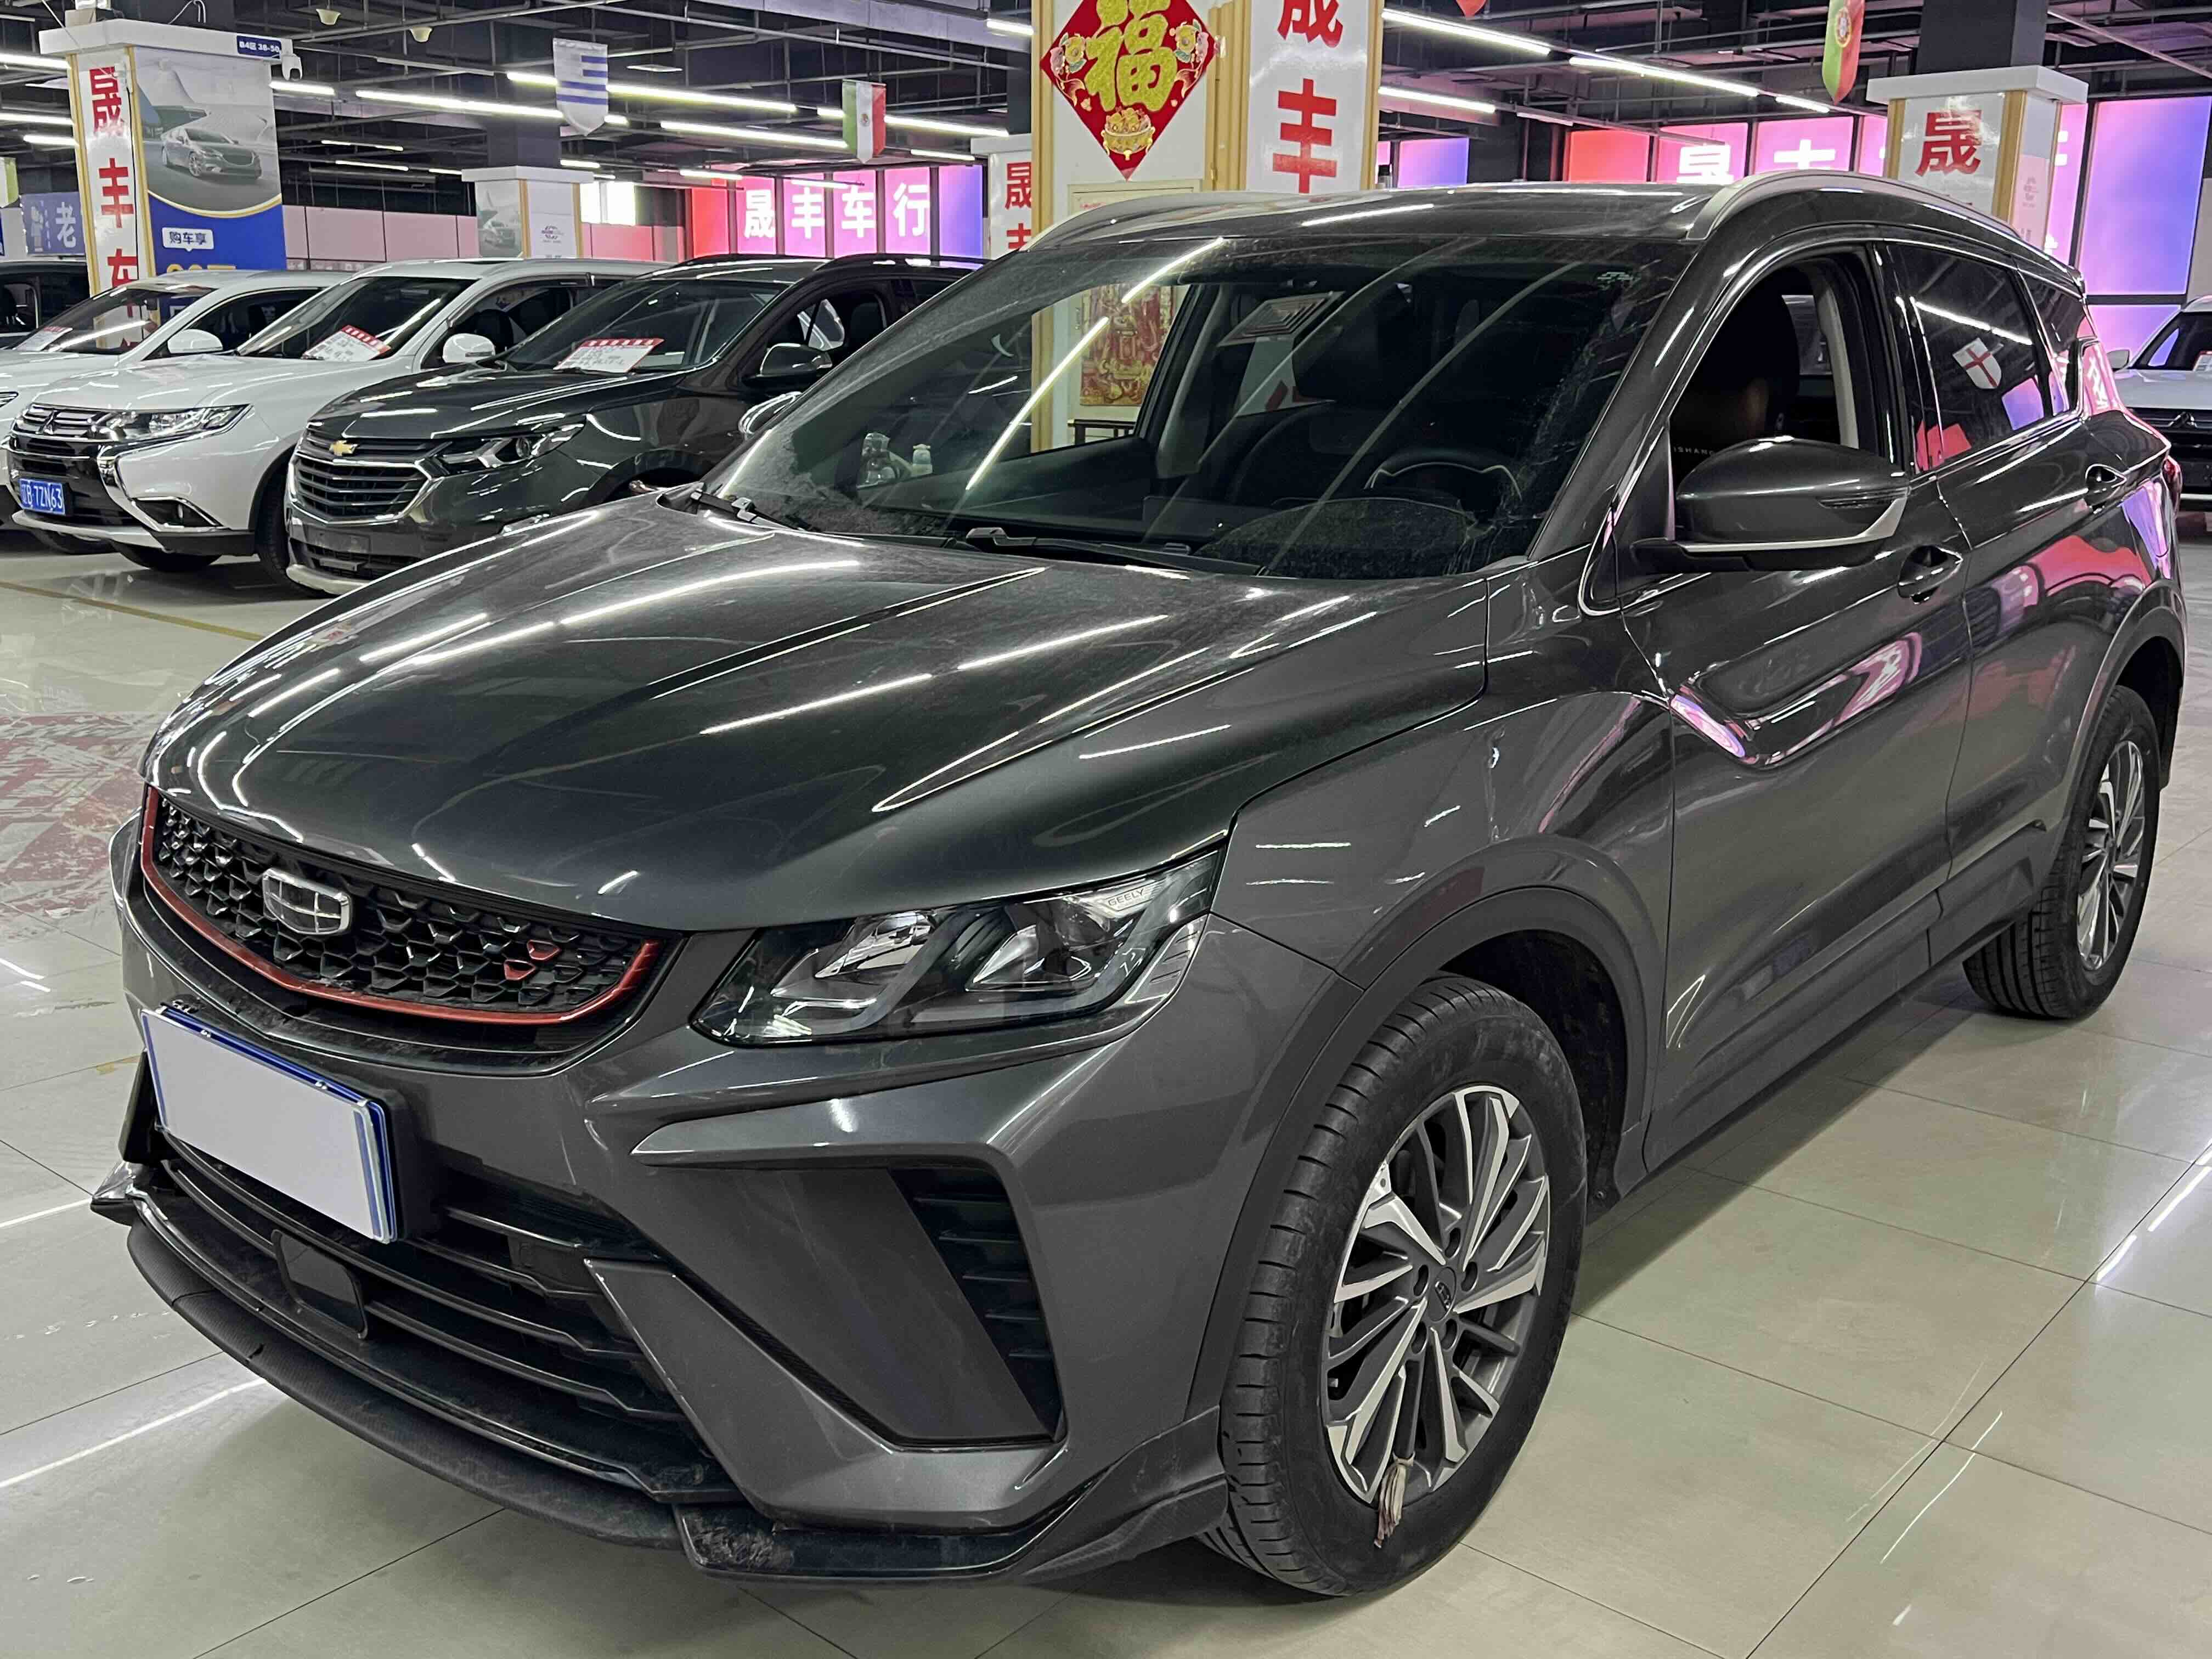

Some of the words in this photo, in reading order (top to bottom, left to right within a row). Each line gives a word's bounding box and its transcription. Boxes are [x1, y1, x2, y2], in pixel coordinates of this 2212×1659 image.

[1084, 0, 1177, 112] 福
[744, 182, 931, 239] 晟丰车行
[1108, 889, 1144, 906] GEELY
